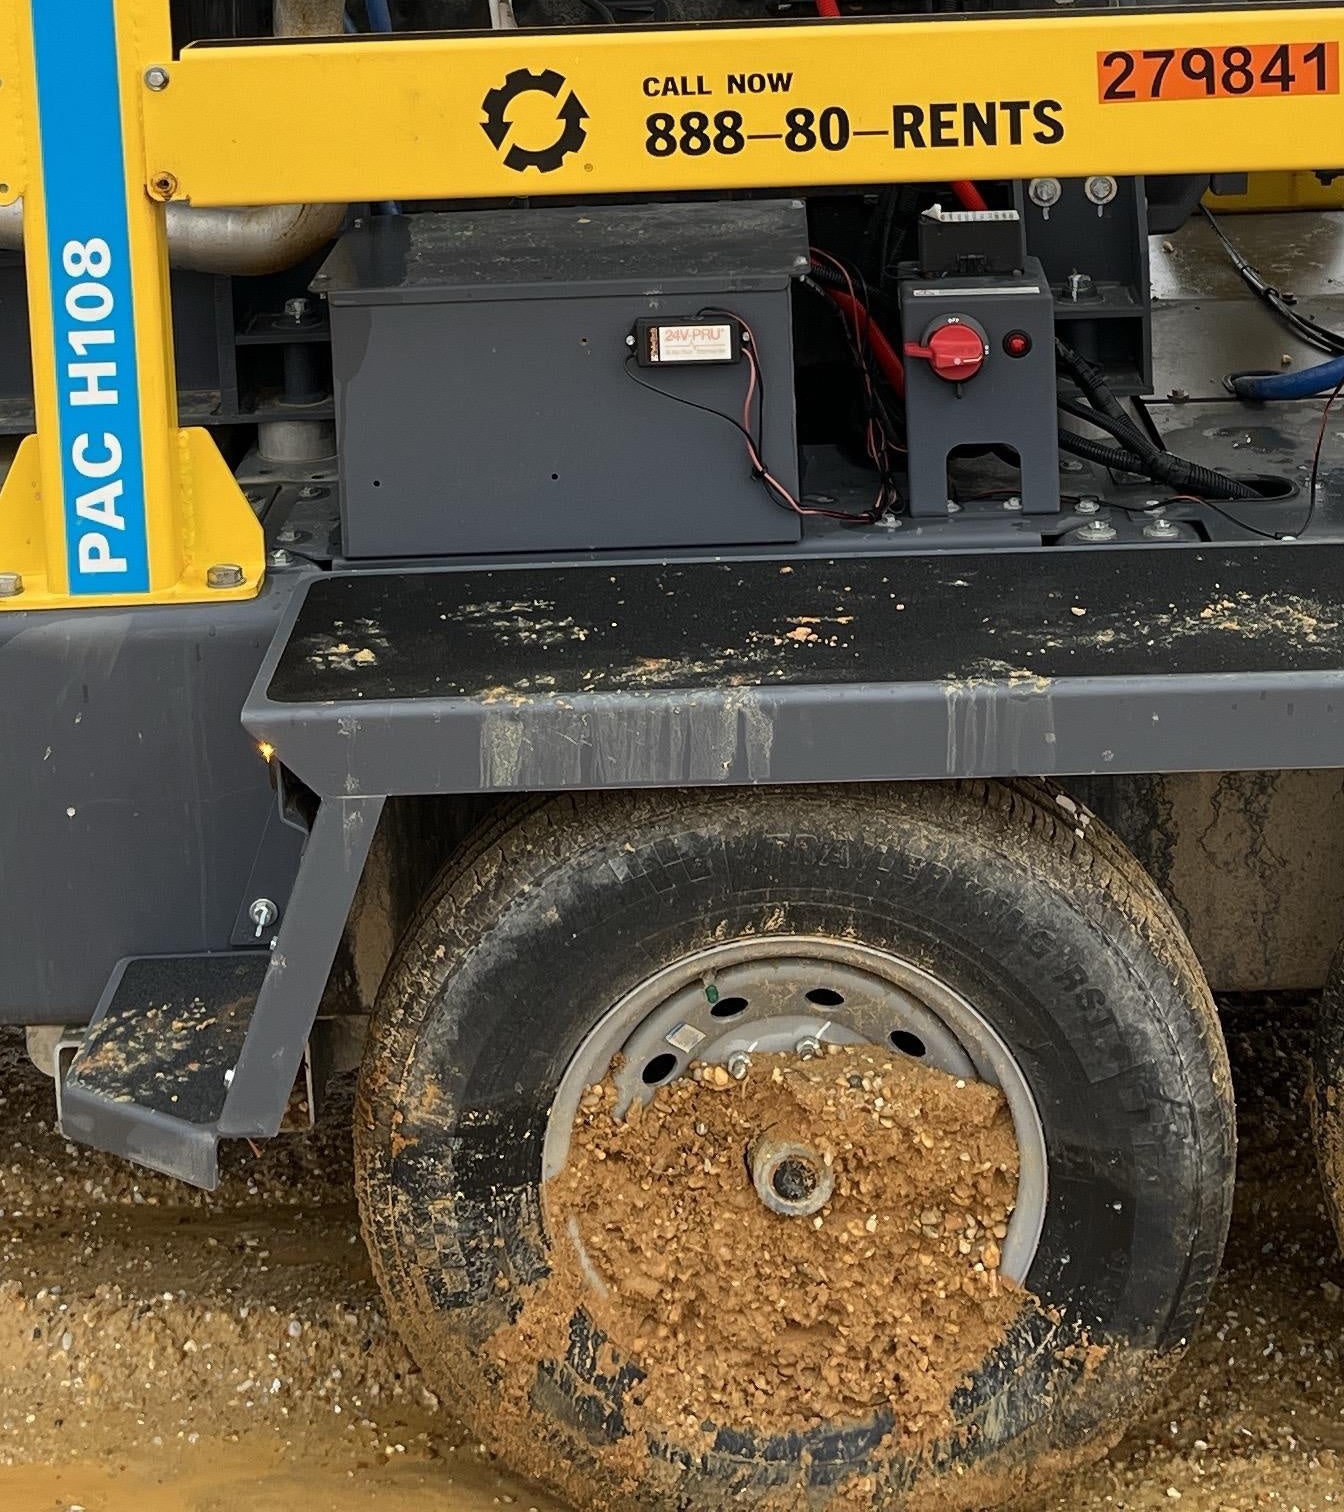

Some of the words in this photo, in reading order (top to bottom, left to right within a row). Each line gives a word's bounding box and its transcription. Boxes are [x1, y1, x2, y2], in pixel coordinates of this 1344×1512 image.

[642, 74, 712, 98] CALL
[727, 72, 793, 95] NOW
[1103, 43, 1326, 100] 279841
[62, 238, 119, 407] H108
[71, 431, 128, 574] PAC
